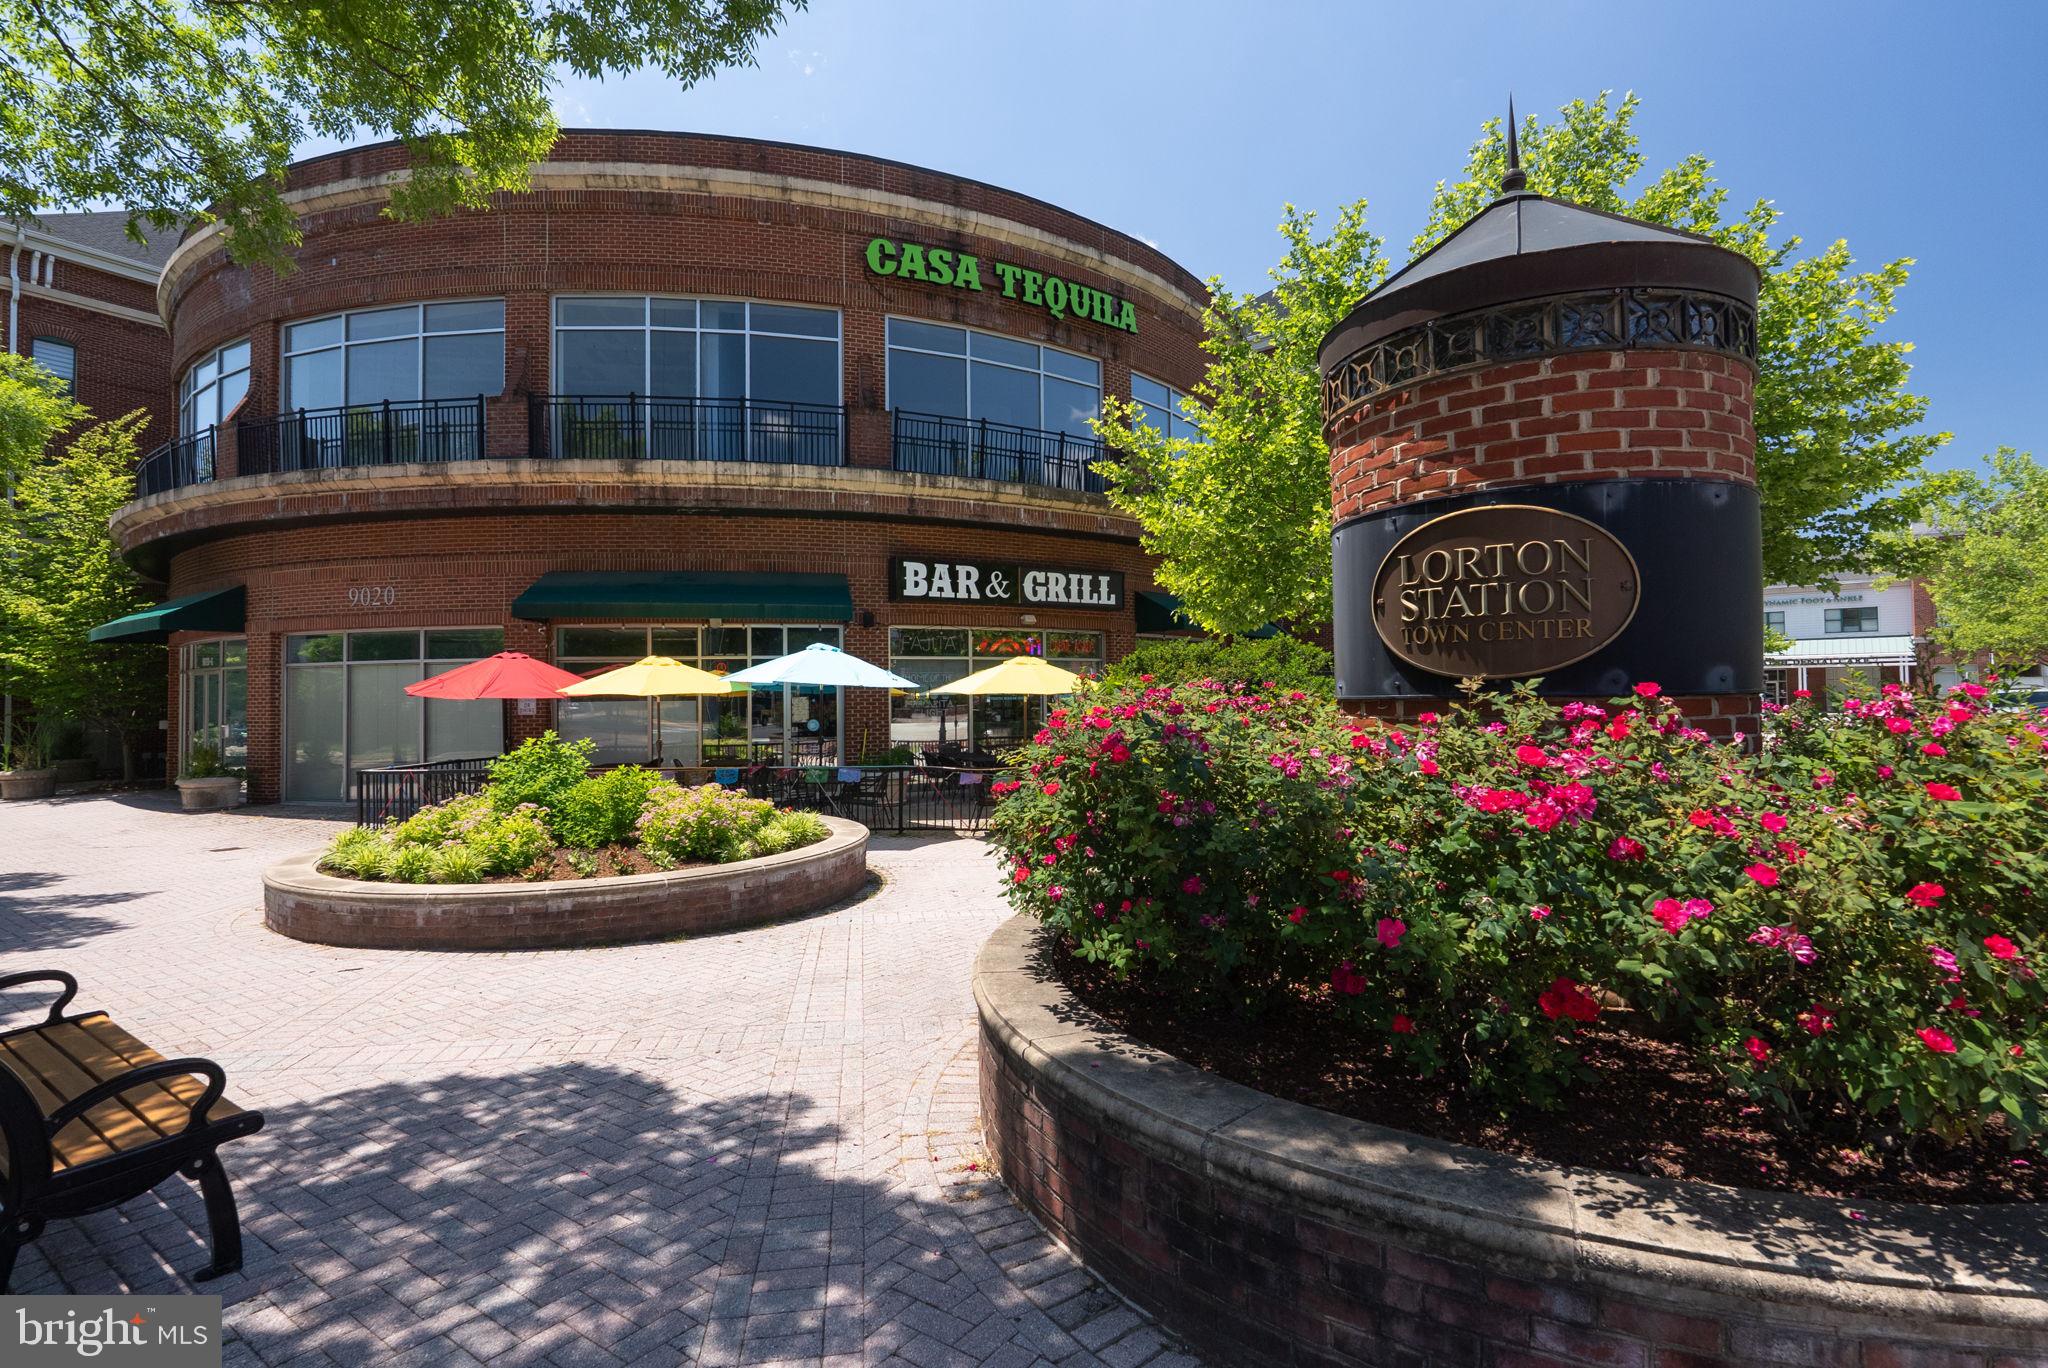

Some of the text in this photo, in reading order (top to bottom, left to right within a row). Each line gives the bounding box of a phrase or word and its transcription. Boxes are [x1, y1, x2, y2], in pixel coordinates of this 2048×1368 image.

[865, 238, 1139, 334] CASA TEQUILA
[903, 561, 1116, 605] BAR & GRILL
[1398, 539, 1593, 587] LORTON
[349, 586, 395, 607] 9020
[1400, 578, 1595, 622] STATION
[1401, 618, 1595, 646] TOWN CENTER
